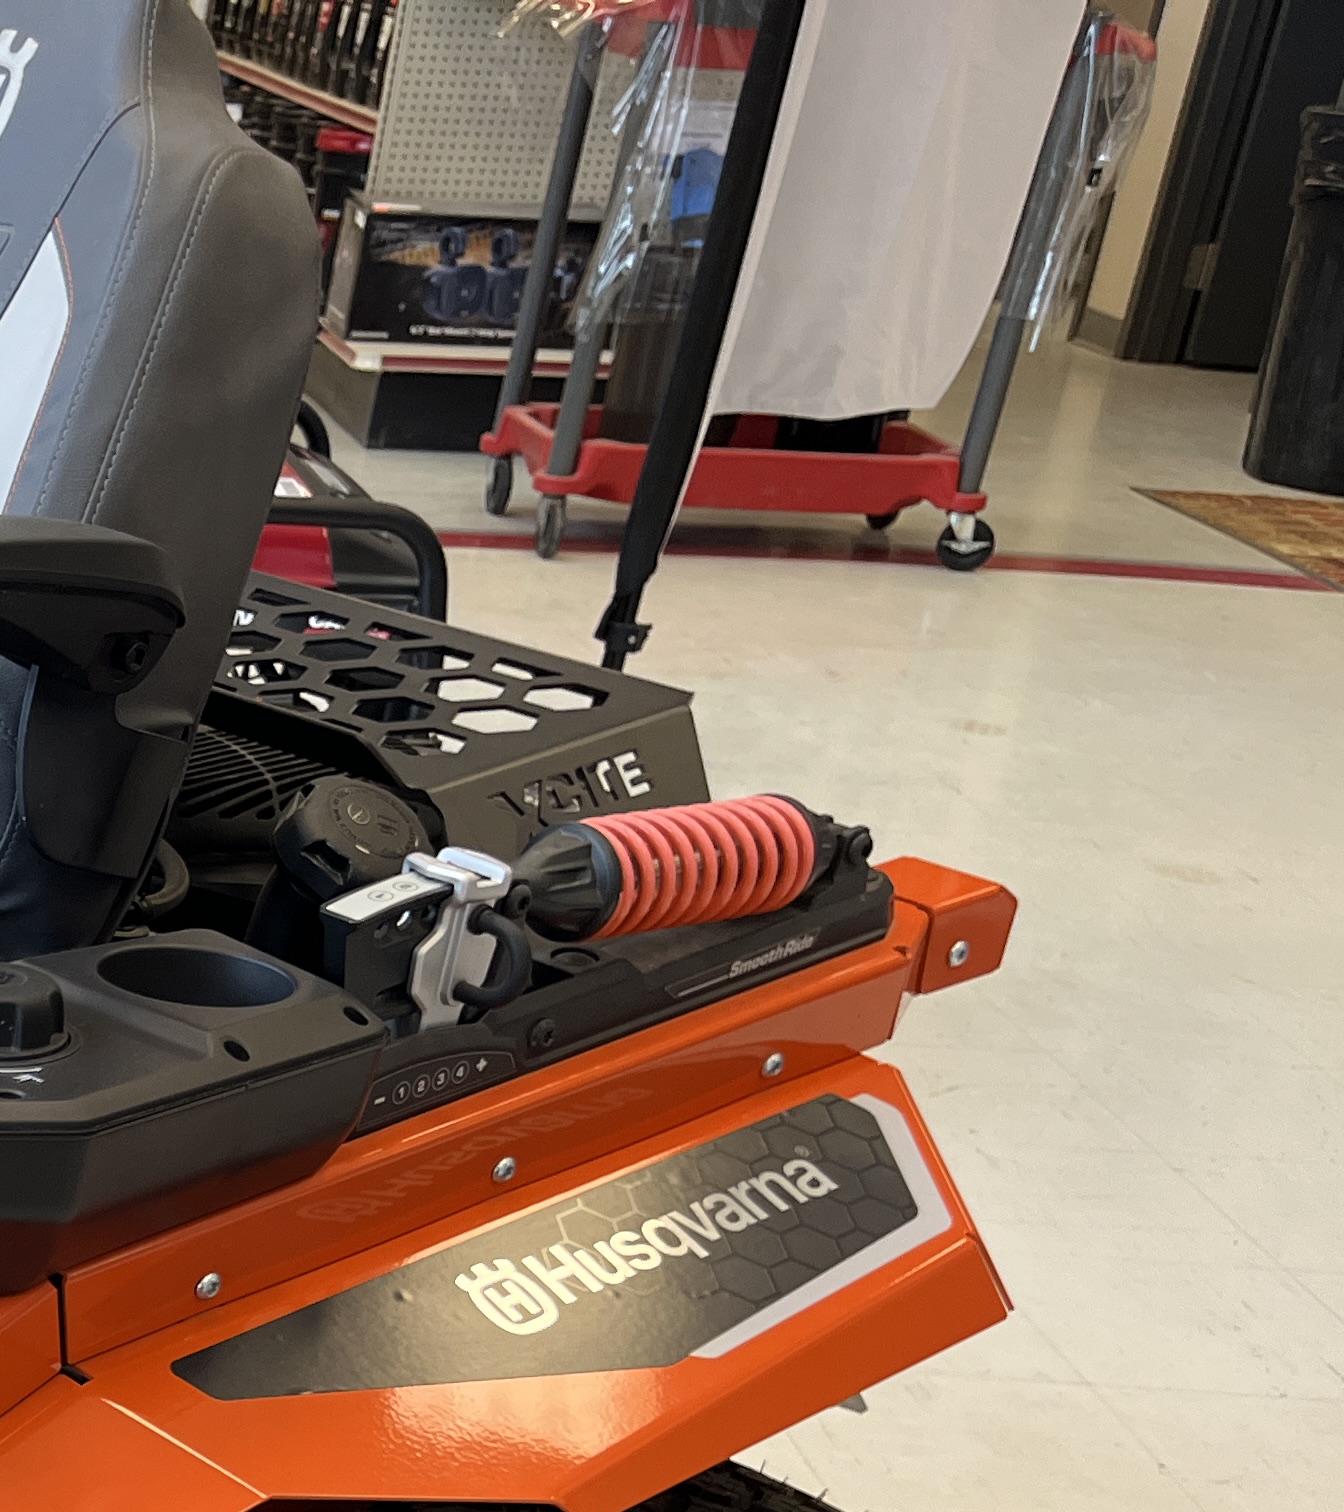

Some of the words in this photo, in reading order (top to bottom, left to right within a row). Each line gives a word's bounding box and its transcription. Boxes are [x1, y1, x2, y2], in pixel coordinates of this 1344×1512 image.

[729, 945, 785, 978] Smooth
[783, 935, 814, 957] Ride
[521, 1158, 839, 1305] Husqvarna
